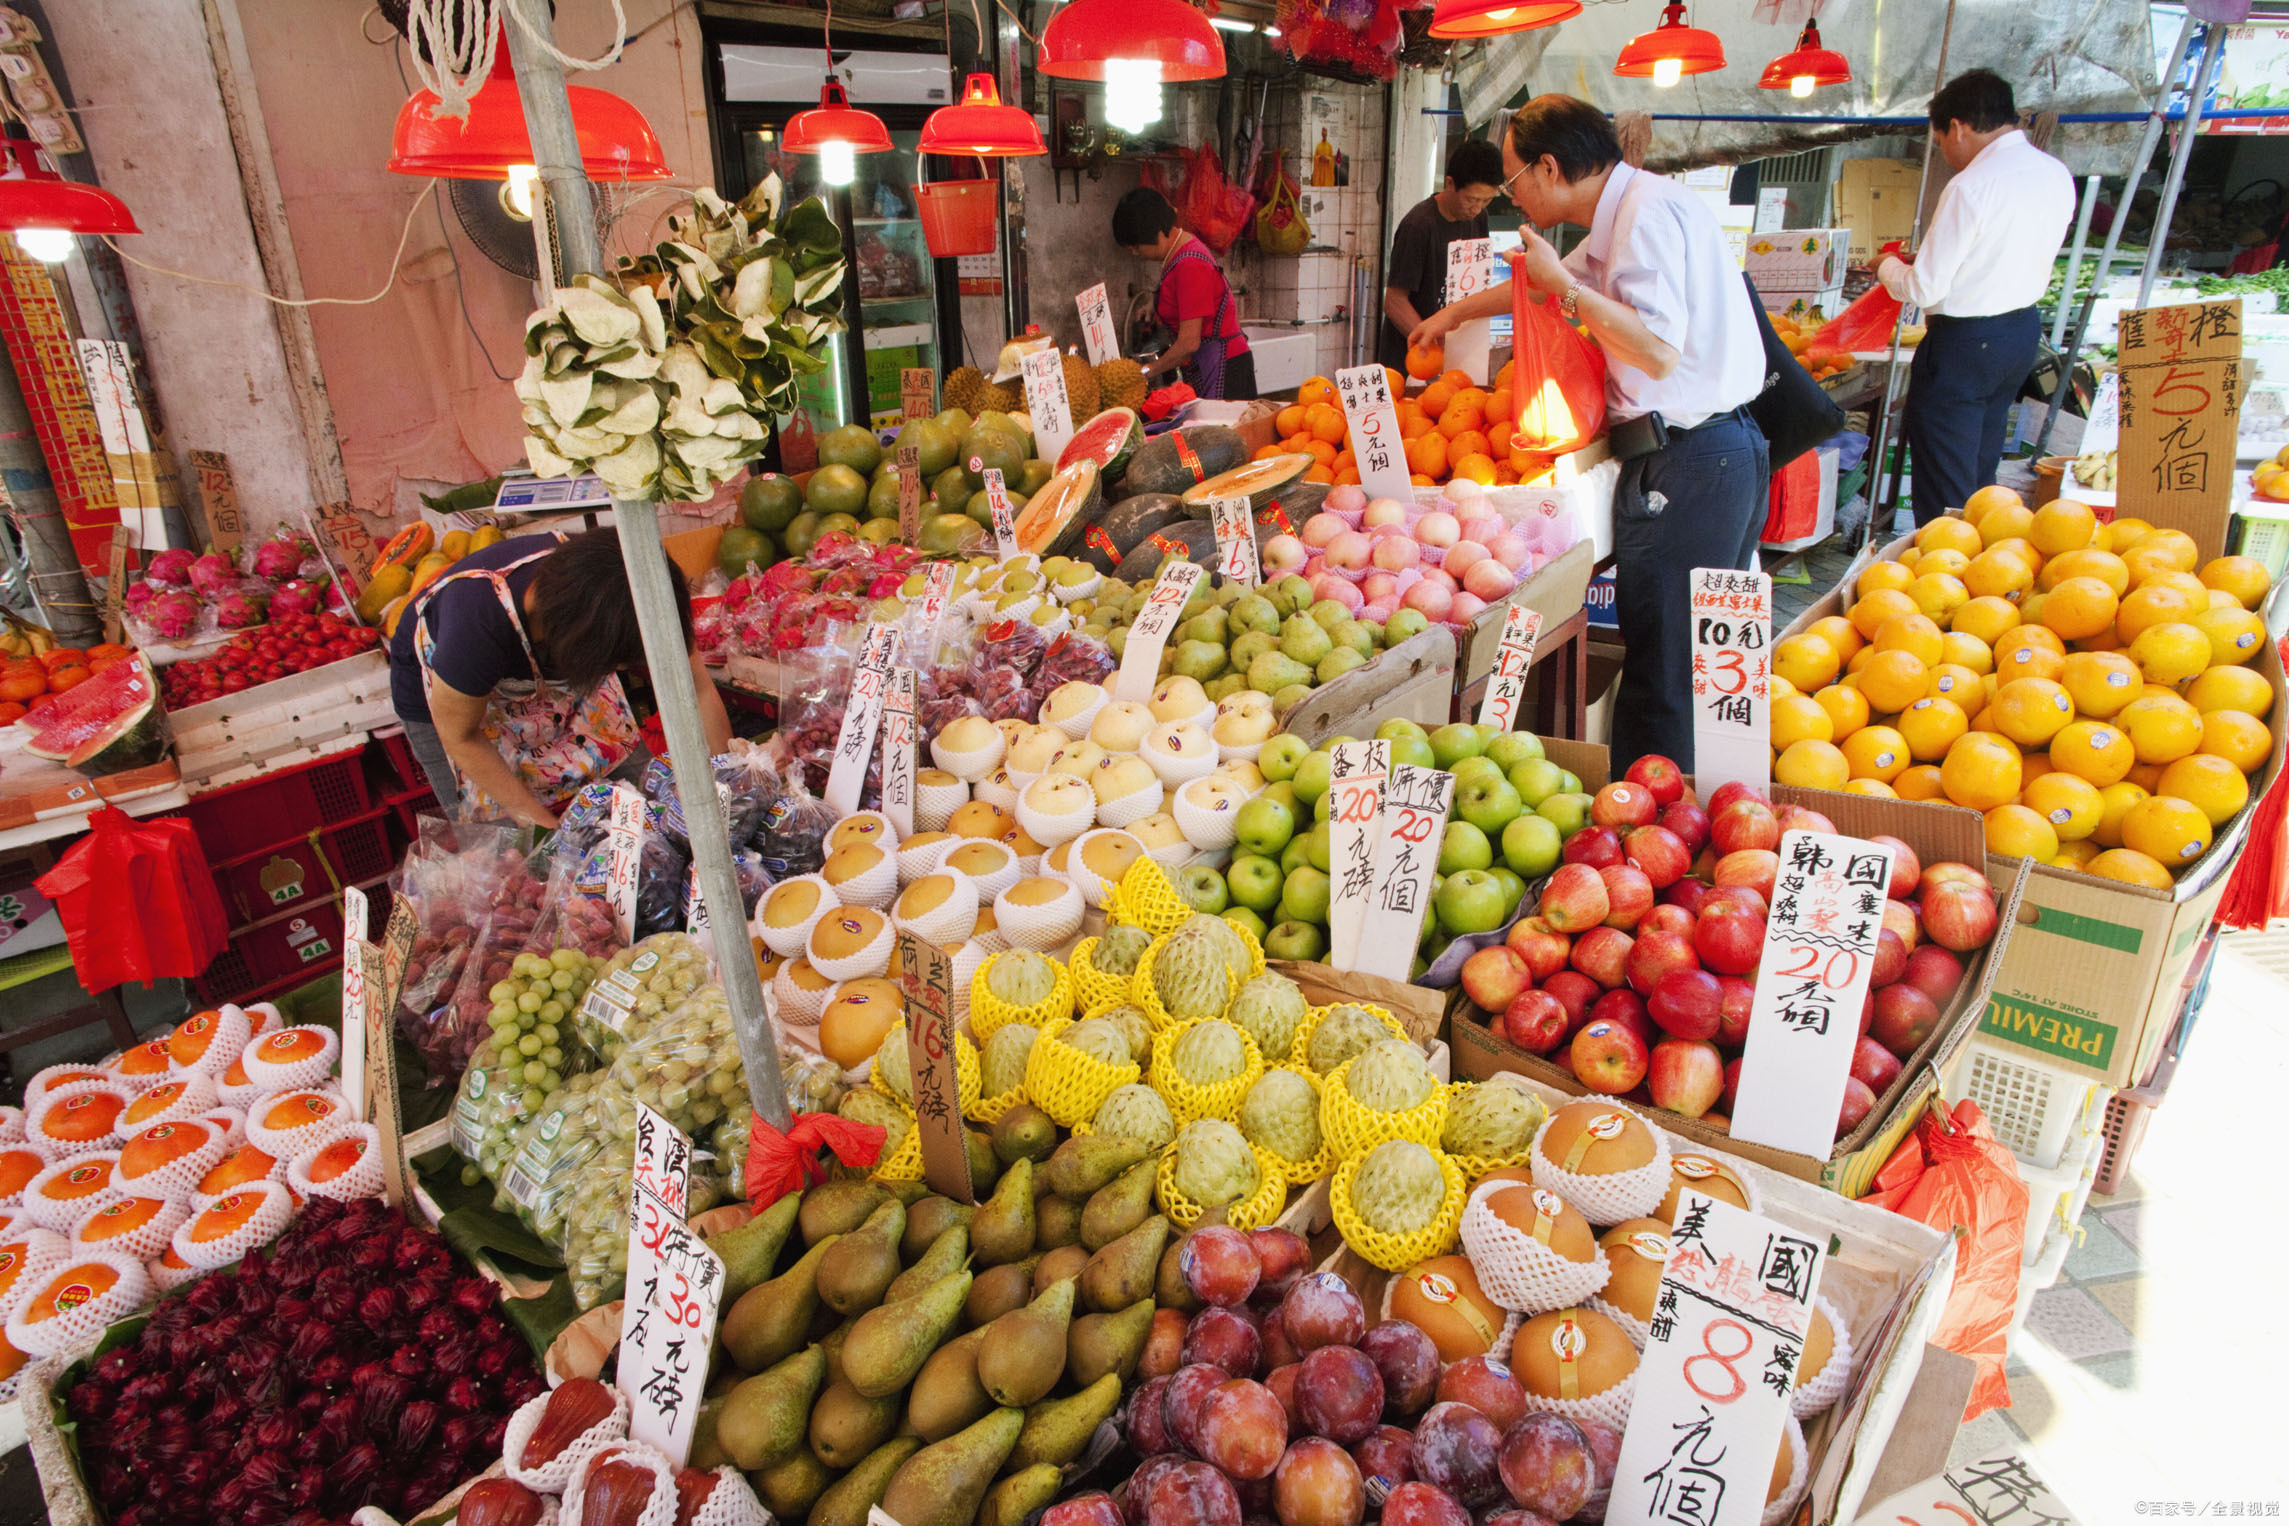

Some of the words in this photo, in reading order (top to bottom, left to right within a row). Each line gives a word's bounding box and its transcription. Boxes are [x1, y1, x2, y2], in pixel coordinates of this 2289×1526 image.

[1460, 266, 1475, 291] 6
[2152, 367, 2211, 416] 5
[1362, 412, 1381, 435] 5
[206, 472, 230, 492] 12
[341, 529, 370, 551] 15
[1229, 540, 1246, 578] 6
[1150, 586, 1181, 604] 12
[1500, 649, 1523, 678] 12
[1710, 649, 1748, 695] 3
[858, 672, 881, 699] 20
[1708, 695, 1752, 727] 個
[889, 715, 910, 746] 12
[1339, 787, 1378, 825] 20
[1390, 808, 1433, 843] 20
[613, 851, 629, 886] 16
[302, 942, 328, 957] 4A
[1774, 945, 1858, 990] 20
[2060, 1001, 2099, 1019] STORE
[913, 1012, 943, 1060] 16
[1986, 1000, 2104, 1056] PREMIU
[665, 1272, 702, 1330] 30
[1682, 1317, 1754, 1405] 8
